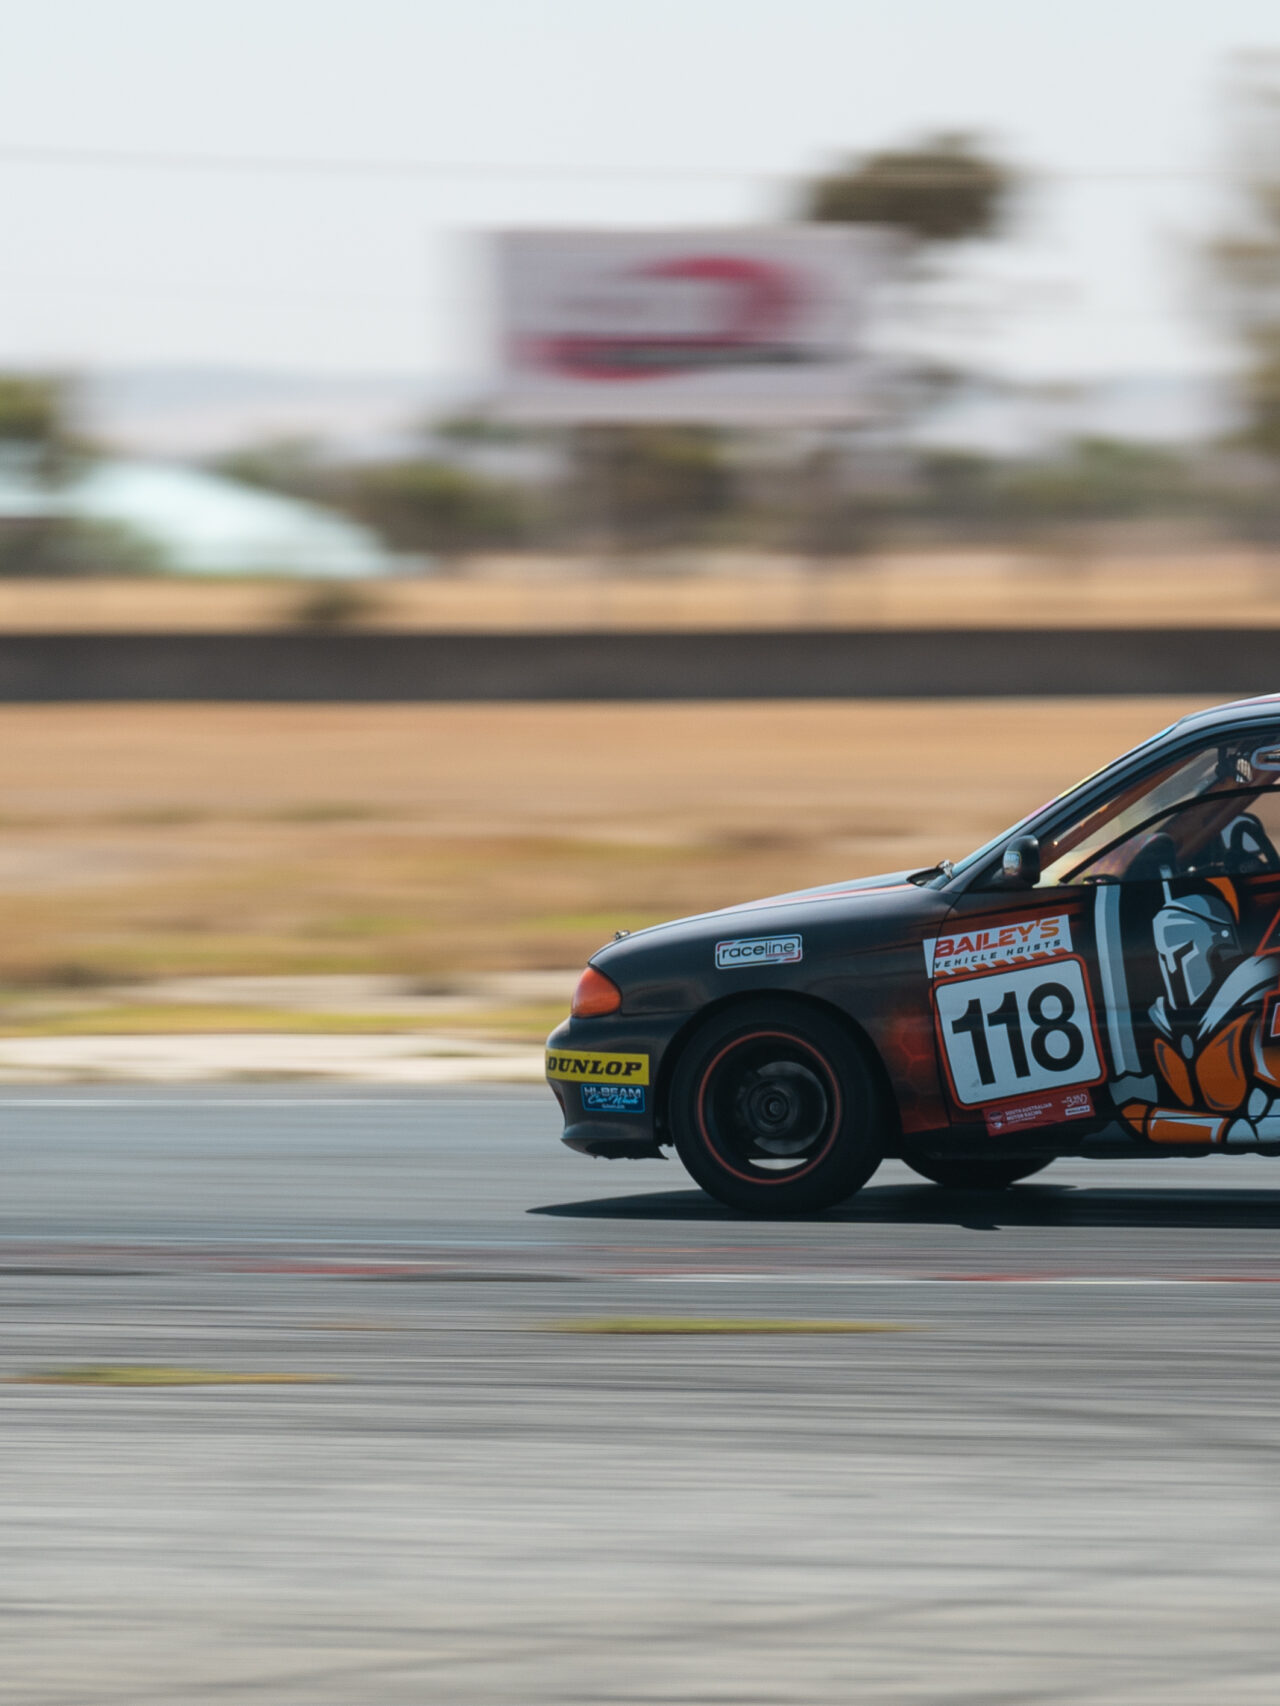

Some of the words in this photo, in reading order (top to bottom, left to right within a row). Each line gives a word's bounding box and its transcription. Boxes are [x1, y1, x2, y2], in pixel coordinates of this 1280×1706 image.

[722, 941, 795, 959] raceline
[934, 919, 1060, 958] BAILEY'S
[935, 952, 998, 968] VEHICLE
[1006, 939, 1061, 956] HOISTS
[951, 982, 1084, 1085] 118
[548, 1056, 642, 1076] DUNLOP
[584, 1087, 642, 1098] HI-BEAM
